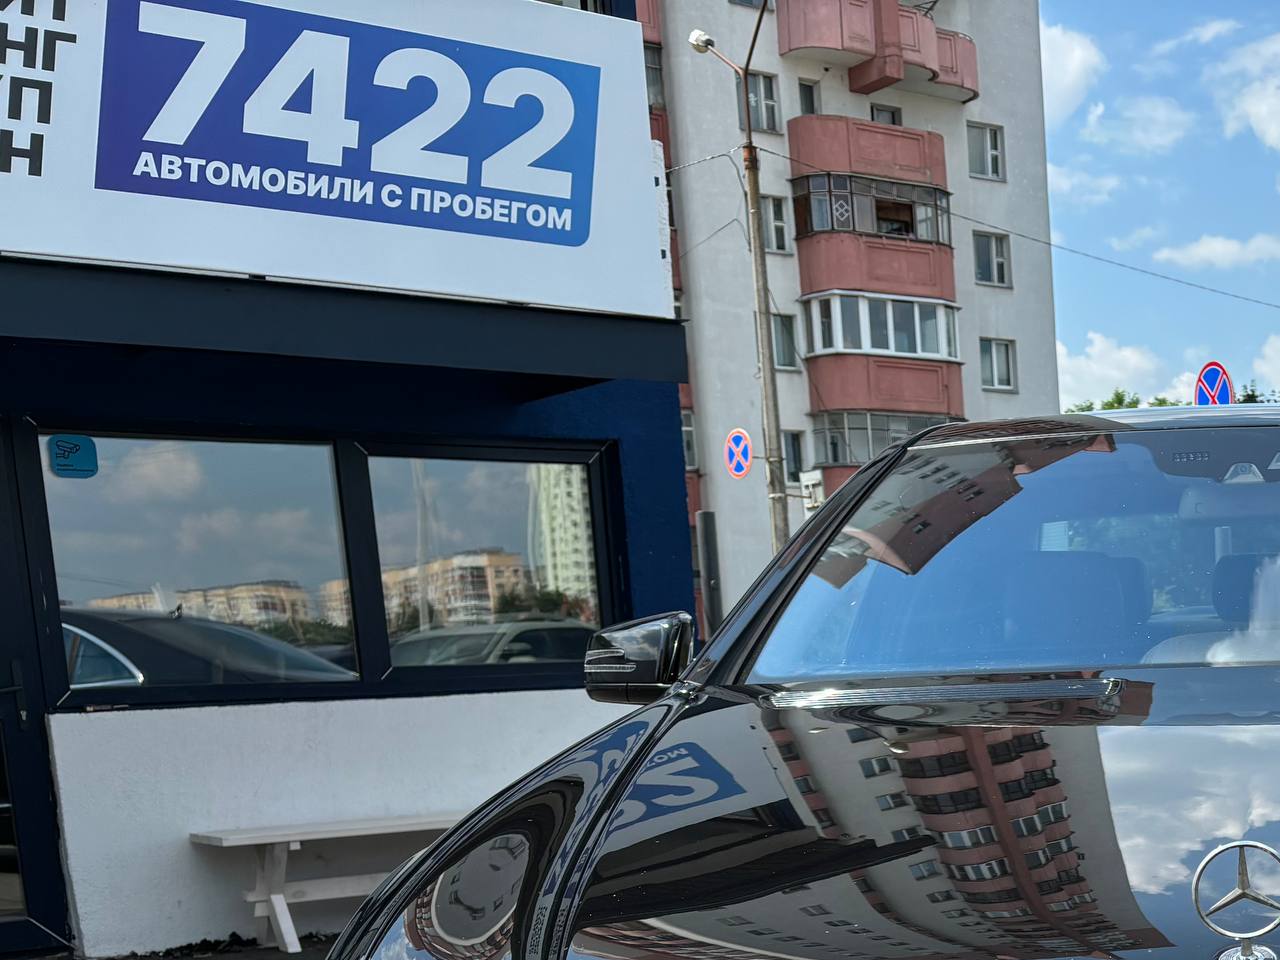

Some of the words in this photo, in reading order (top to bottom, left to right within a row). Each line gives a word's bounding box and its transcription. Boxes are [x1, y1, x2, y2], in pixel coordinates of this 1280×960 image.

[138, 1, 575, 199] 7422
[133, 151, 374, 206] АВТОМОБИЛИ
[380, 183, 403, 209] С
[410, 187, 572, 232] ПРОБЕГОМ
